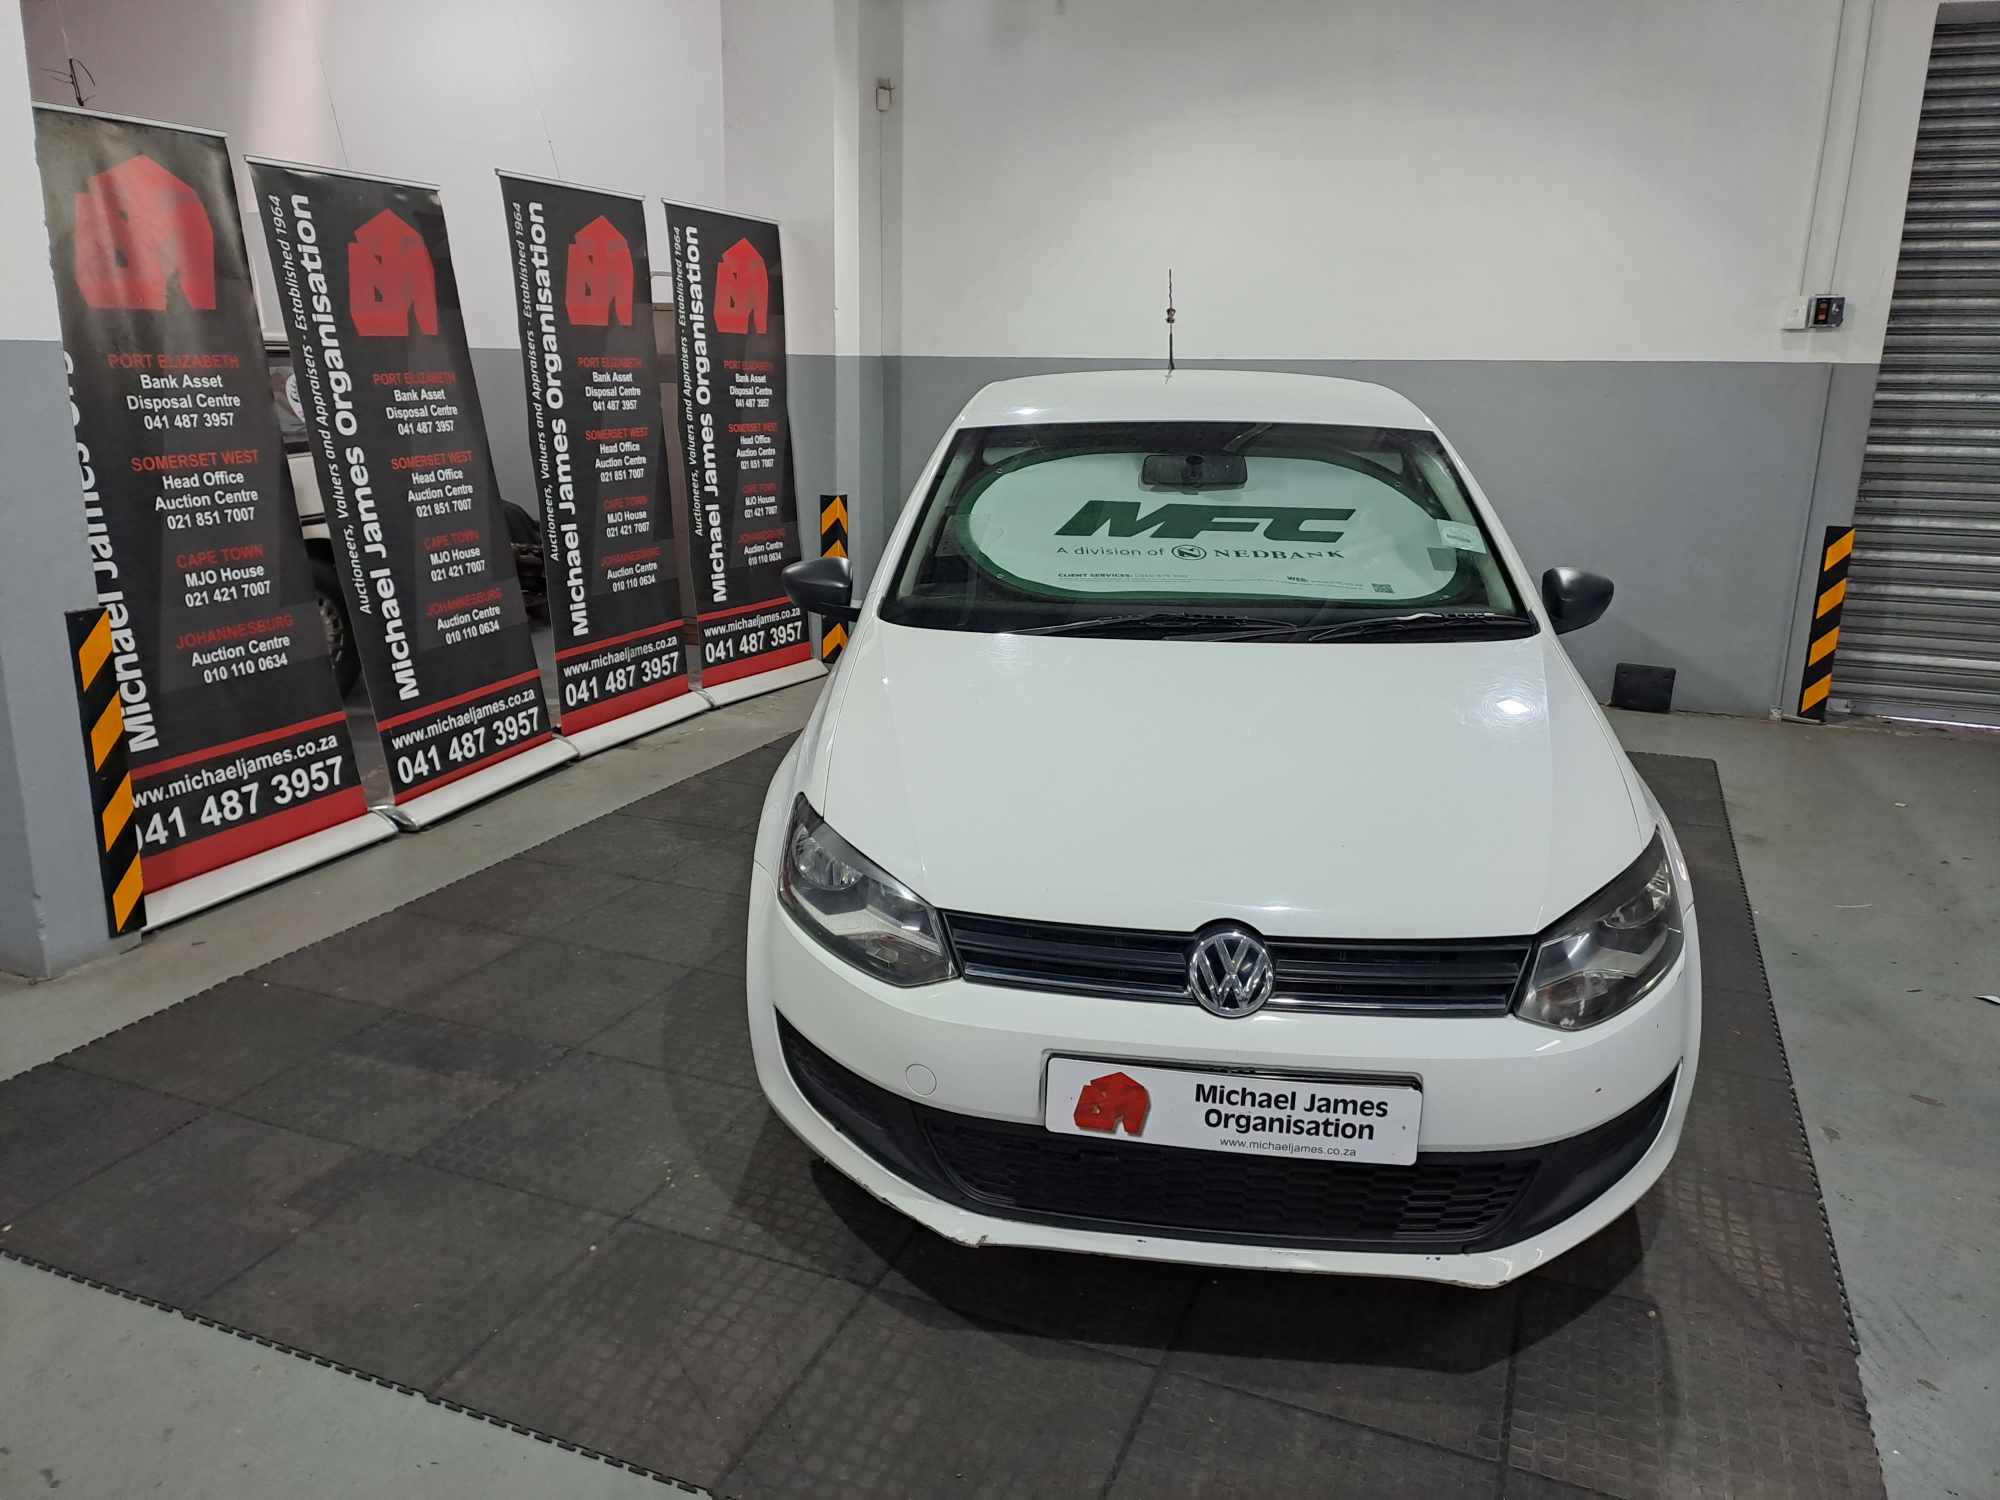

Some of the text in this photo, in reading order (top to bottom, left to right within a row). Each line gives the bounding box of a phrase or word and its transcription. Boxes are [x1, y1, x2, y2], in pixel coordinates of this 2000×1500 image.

[107, 353, 240, 368] PORT ELIZABETH
[140, 374, 224, 389] Bank Asset
[513, 202, 560, 562] Auctioneers, Valuers and Appraisers Established 1964
[592, 372, 632, 382] Bank Asset
[126, 393, 241, 412] Disposal Centre
[394, 389, 445, 401] Bank Asset
[585, 386, 640, 398] Disposal Centre
[268, 194, 372, 615] Auctioneers, Valuers and Appraisers Established 1964
[386, 405, 458, 420] Disposal Centre
[685, 226, 727, 602] Michael James Organisation
[144, 412, 234, 430] 041 487 3957
[398, 420, 454, 435] 041 487 3957
[529, 202, 588, 636] Michael James Organisation
[291, 194, 420, 701] Michael James Organisation
[600, 442, 640, 454] Head Office
[130, 449, 260, 472] SOMERSET WEST
[595, 456, 646, 469] Auction Centre
[162, 470, 244, 490] Head Office
[411, 468, 463, 484] Head Office
[155, 490, 258, 512] Auction Centre
[408, 484, 473, 502] Auction Centre
[167, 507, 255, 530] 021 851 7007
[416, 499, 471, 518] 021 851 7007
[607, 510, 647, 523] MJO House
[1053, 500, 1356, 543] MFC
[176, 544, 264, 568] CAPE TOWN
[430, 547, 480, 565] MJO House
[1074, 545, 1141, 557] division
[1148, 548, 1164, 557] of
[1214, 549, 1345, 559] NEDBANK
[184, 564, 264, 588] MJO House
[431, 560, 485, 581] 021 421 7007
[607, 562, 658, 580] Auction Centre
[185, 580, 271, 607] 021 421 7007
[437, 606, 500, 631] Auction Centre
[704, 608, 800, 637] www.michaeljames.co.za
[176, 614, 294, 649] JOHANNESBURG
[445, 620, 499, 644] 010 110 0634
[705, 621, 802, 663] 041 487 3957
[191, 635, 291, 667] Auction Centre
[563, 636, 677, 677] www.michaeljames.co.za
[98, 591, 159, 752] Michael
[203, 653, 288, 684] 010 110 0634
[565, 651, 679, 707] 041 487 3957
[392, 689, 535, 749] www.michaeljames.co.za
[398, 707, 539, 783] 041 487 3957
[200, 782, 259, 826] 487
[271, 756, 343, 804] 3957
[1195, 1084, 1388, 1117] Michael James
[1204, 1109, 1375, 1140] Organisation
[1219, 1137, 1357, 1157] www.michaeljames.co.za
